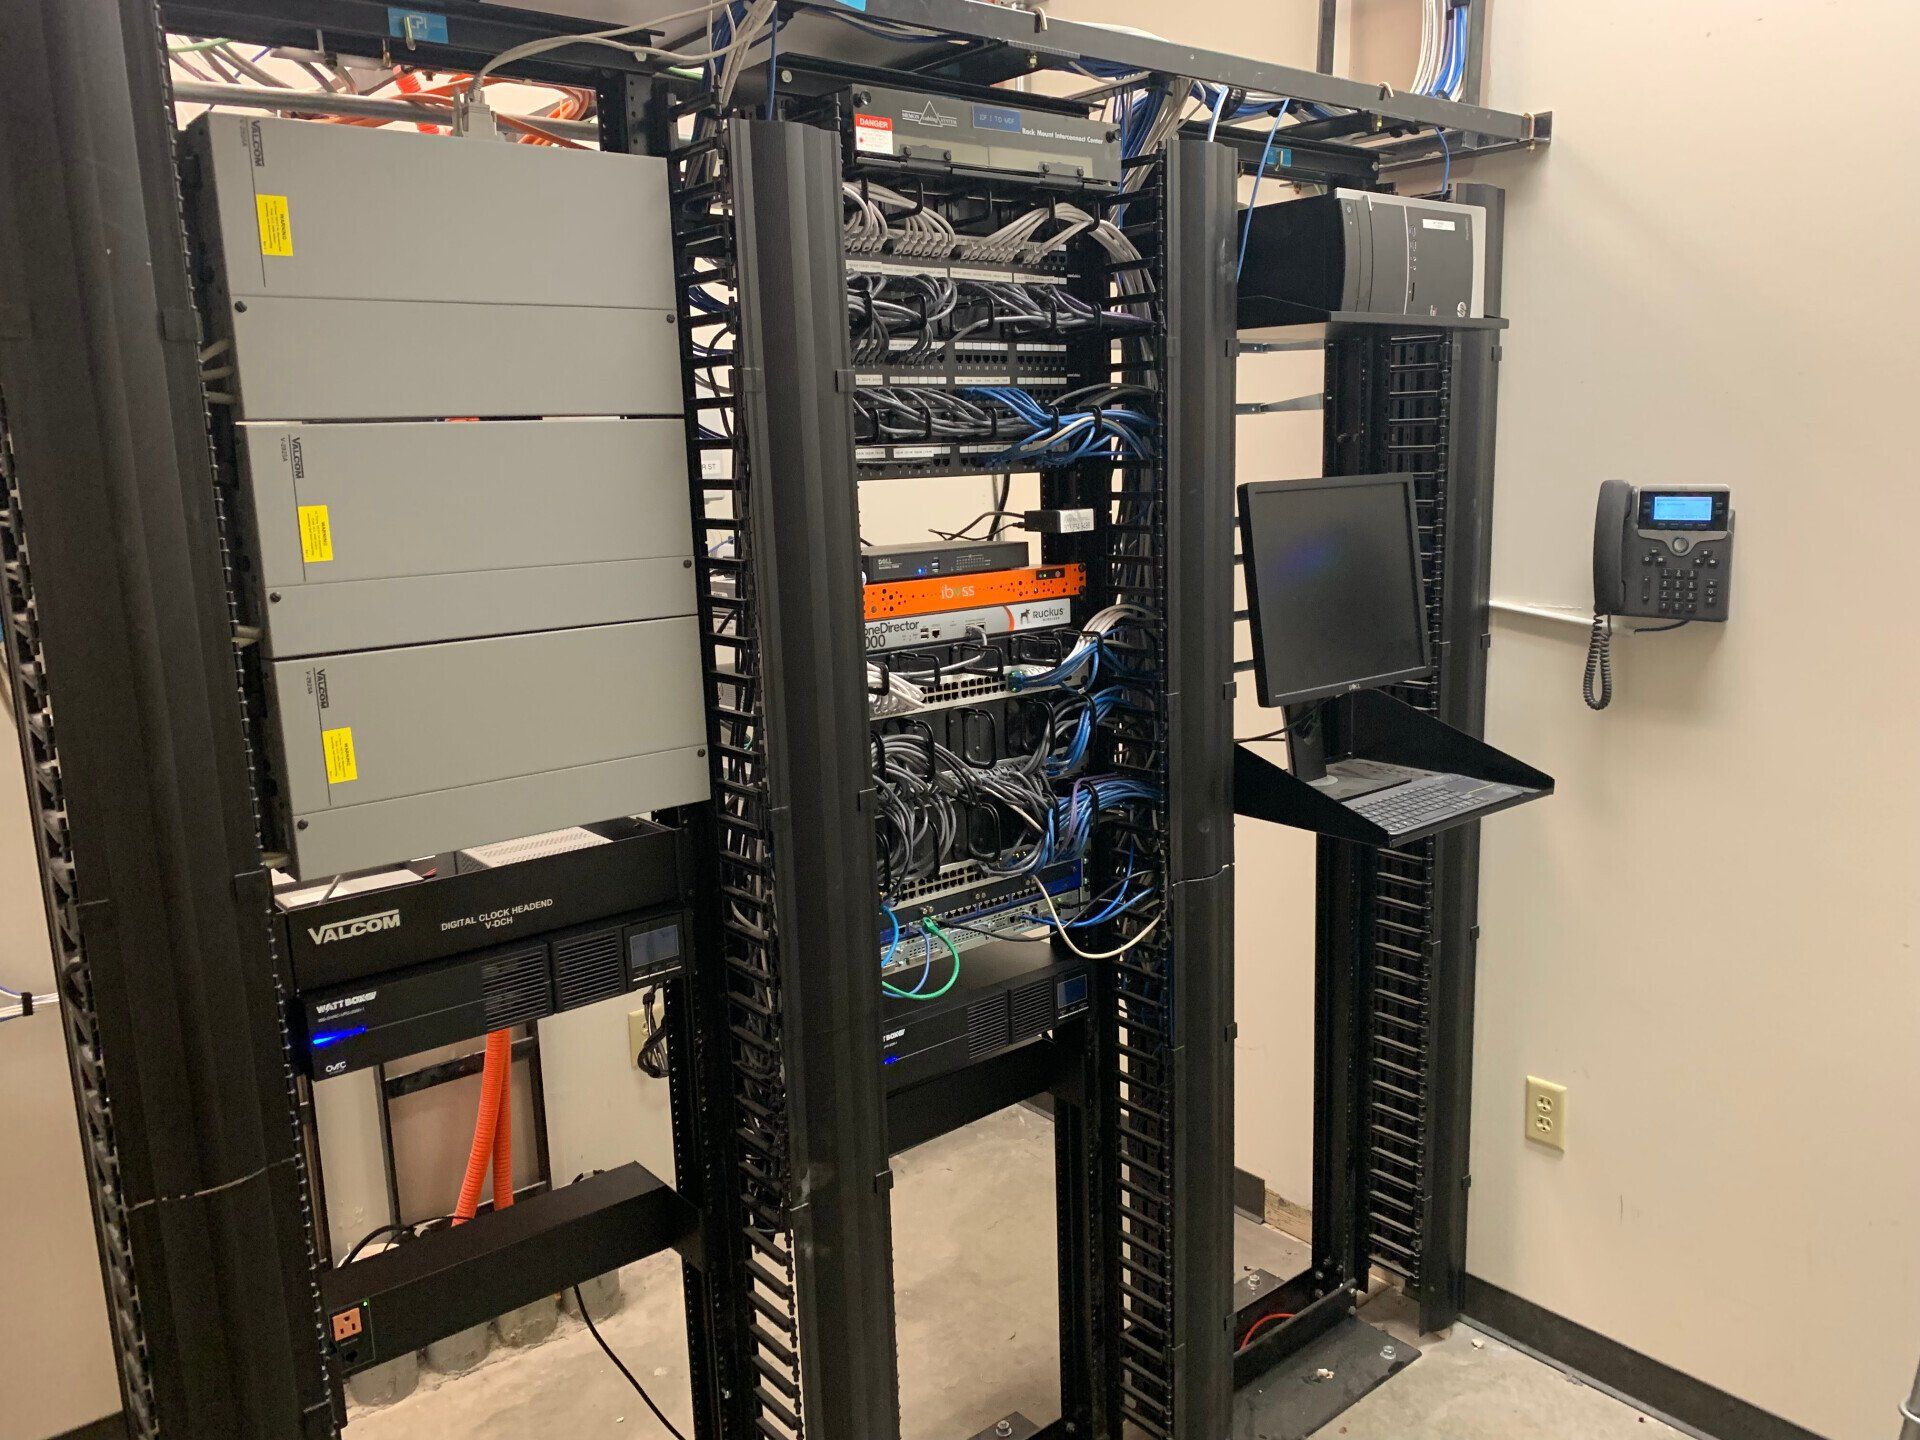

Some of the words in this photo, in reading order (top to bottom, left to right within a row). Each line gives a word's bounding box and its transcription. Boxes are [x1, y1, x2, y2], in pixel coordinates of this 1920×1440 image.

[859, 117, 889, 129] DANGER
[1021, 127, 1036, 136] Rack
[1036, 130, 1054, 138] Mount
[1054, 132, 1086, 142] Interconnect
[1086, 136, 1104, 145] Center
[250, 120, 265, 167] VALCOM
[279, 213, 287, 240] WARNING
[292, 436, 305, 479] VALCOM
[864, 620, 920, 635] oneDirector
[865, 634, 886, 649] 000
[316, 668, 330, 709] VALCOM
[307, 909, 401, 946] VALCOM
[441, 916, 477, 931] DIGITAL
[478, 908, 510, 922] CLOCK
[511, 898, 554, 915] HEADEND
[484, 916, 514, 930] V-DCH
